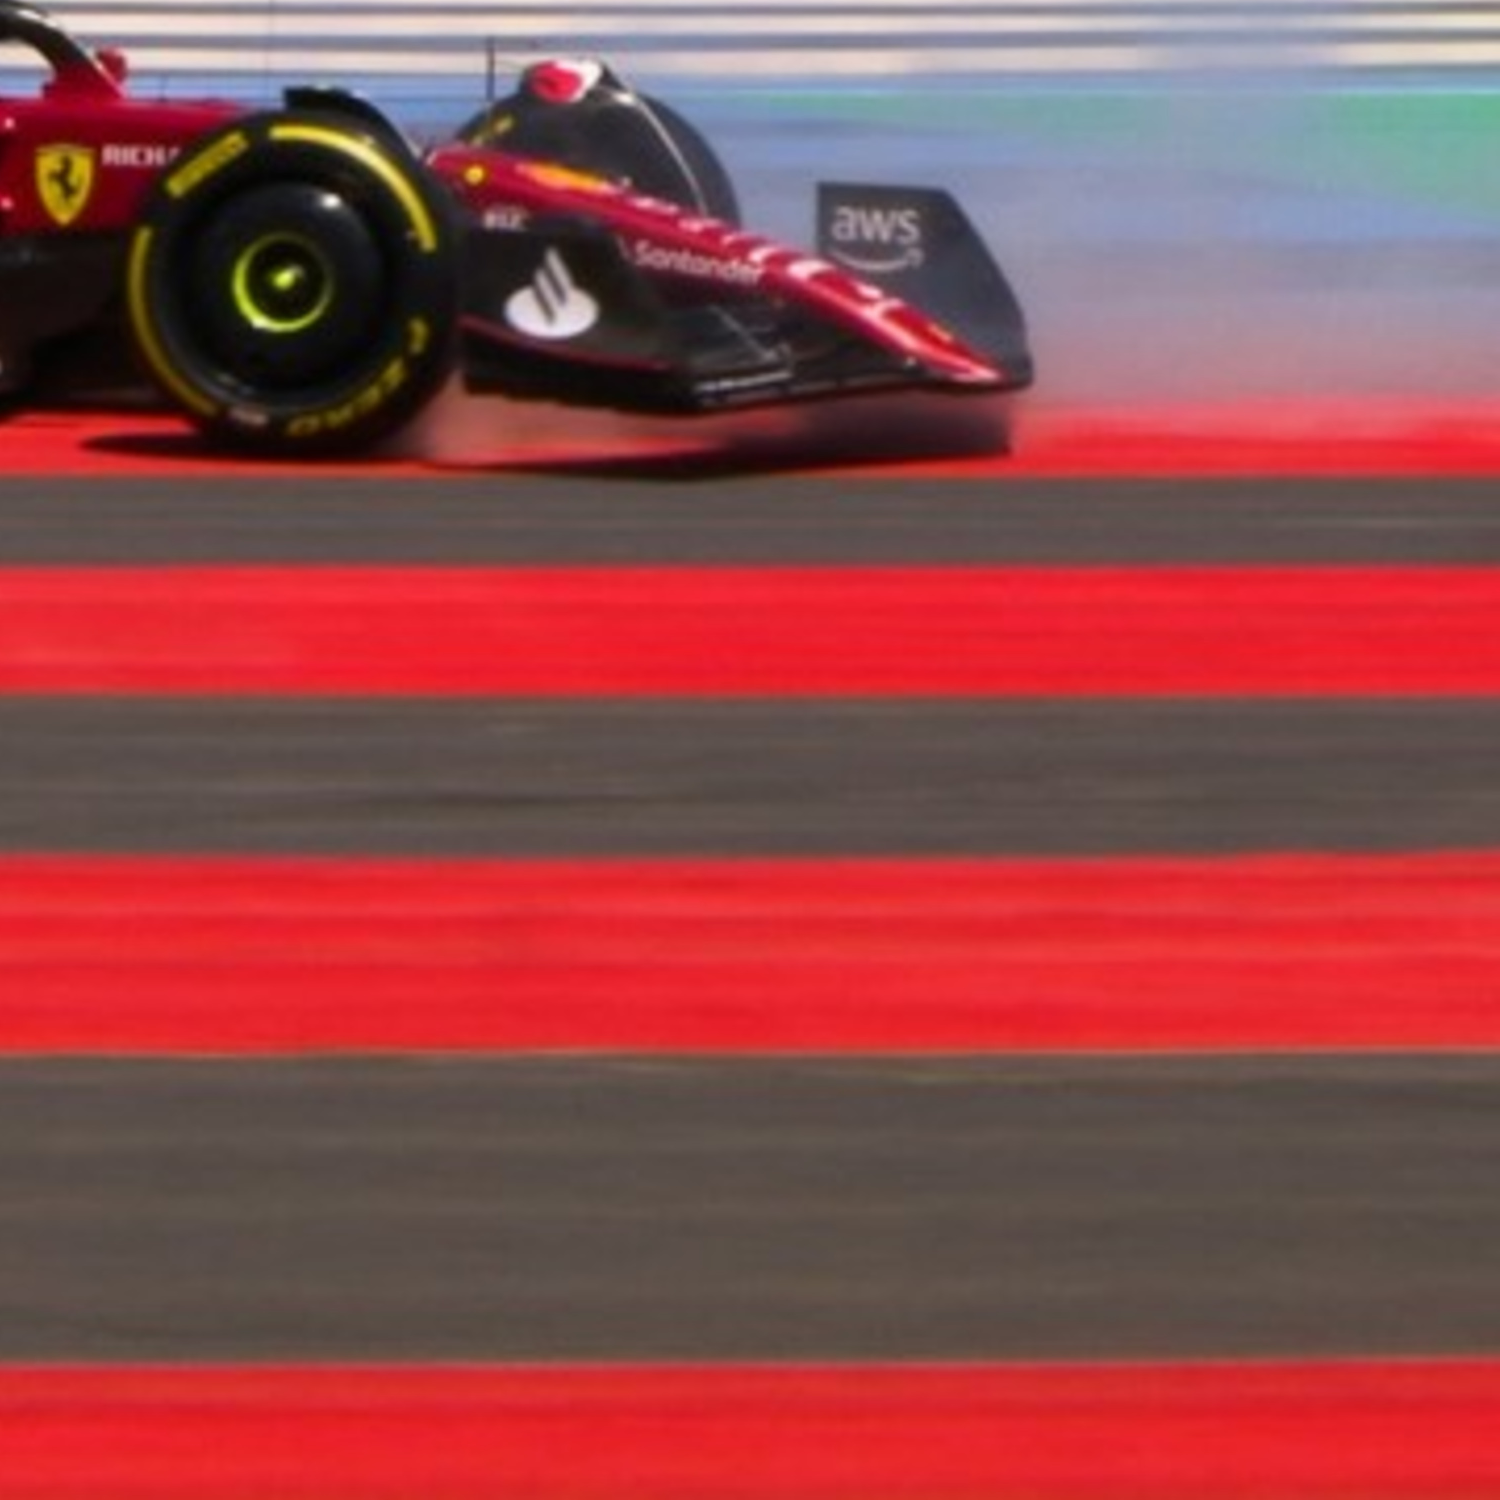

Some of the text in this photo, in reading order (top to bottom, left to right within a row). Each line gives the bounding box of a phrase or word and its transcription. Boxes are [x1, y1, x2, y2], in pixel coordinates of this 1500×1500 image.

[101, 143, 181, 167] RICH
[830, 204, 921, 245] aws
[634, 240, 764, 286] Santander
